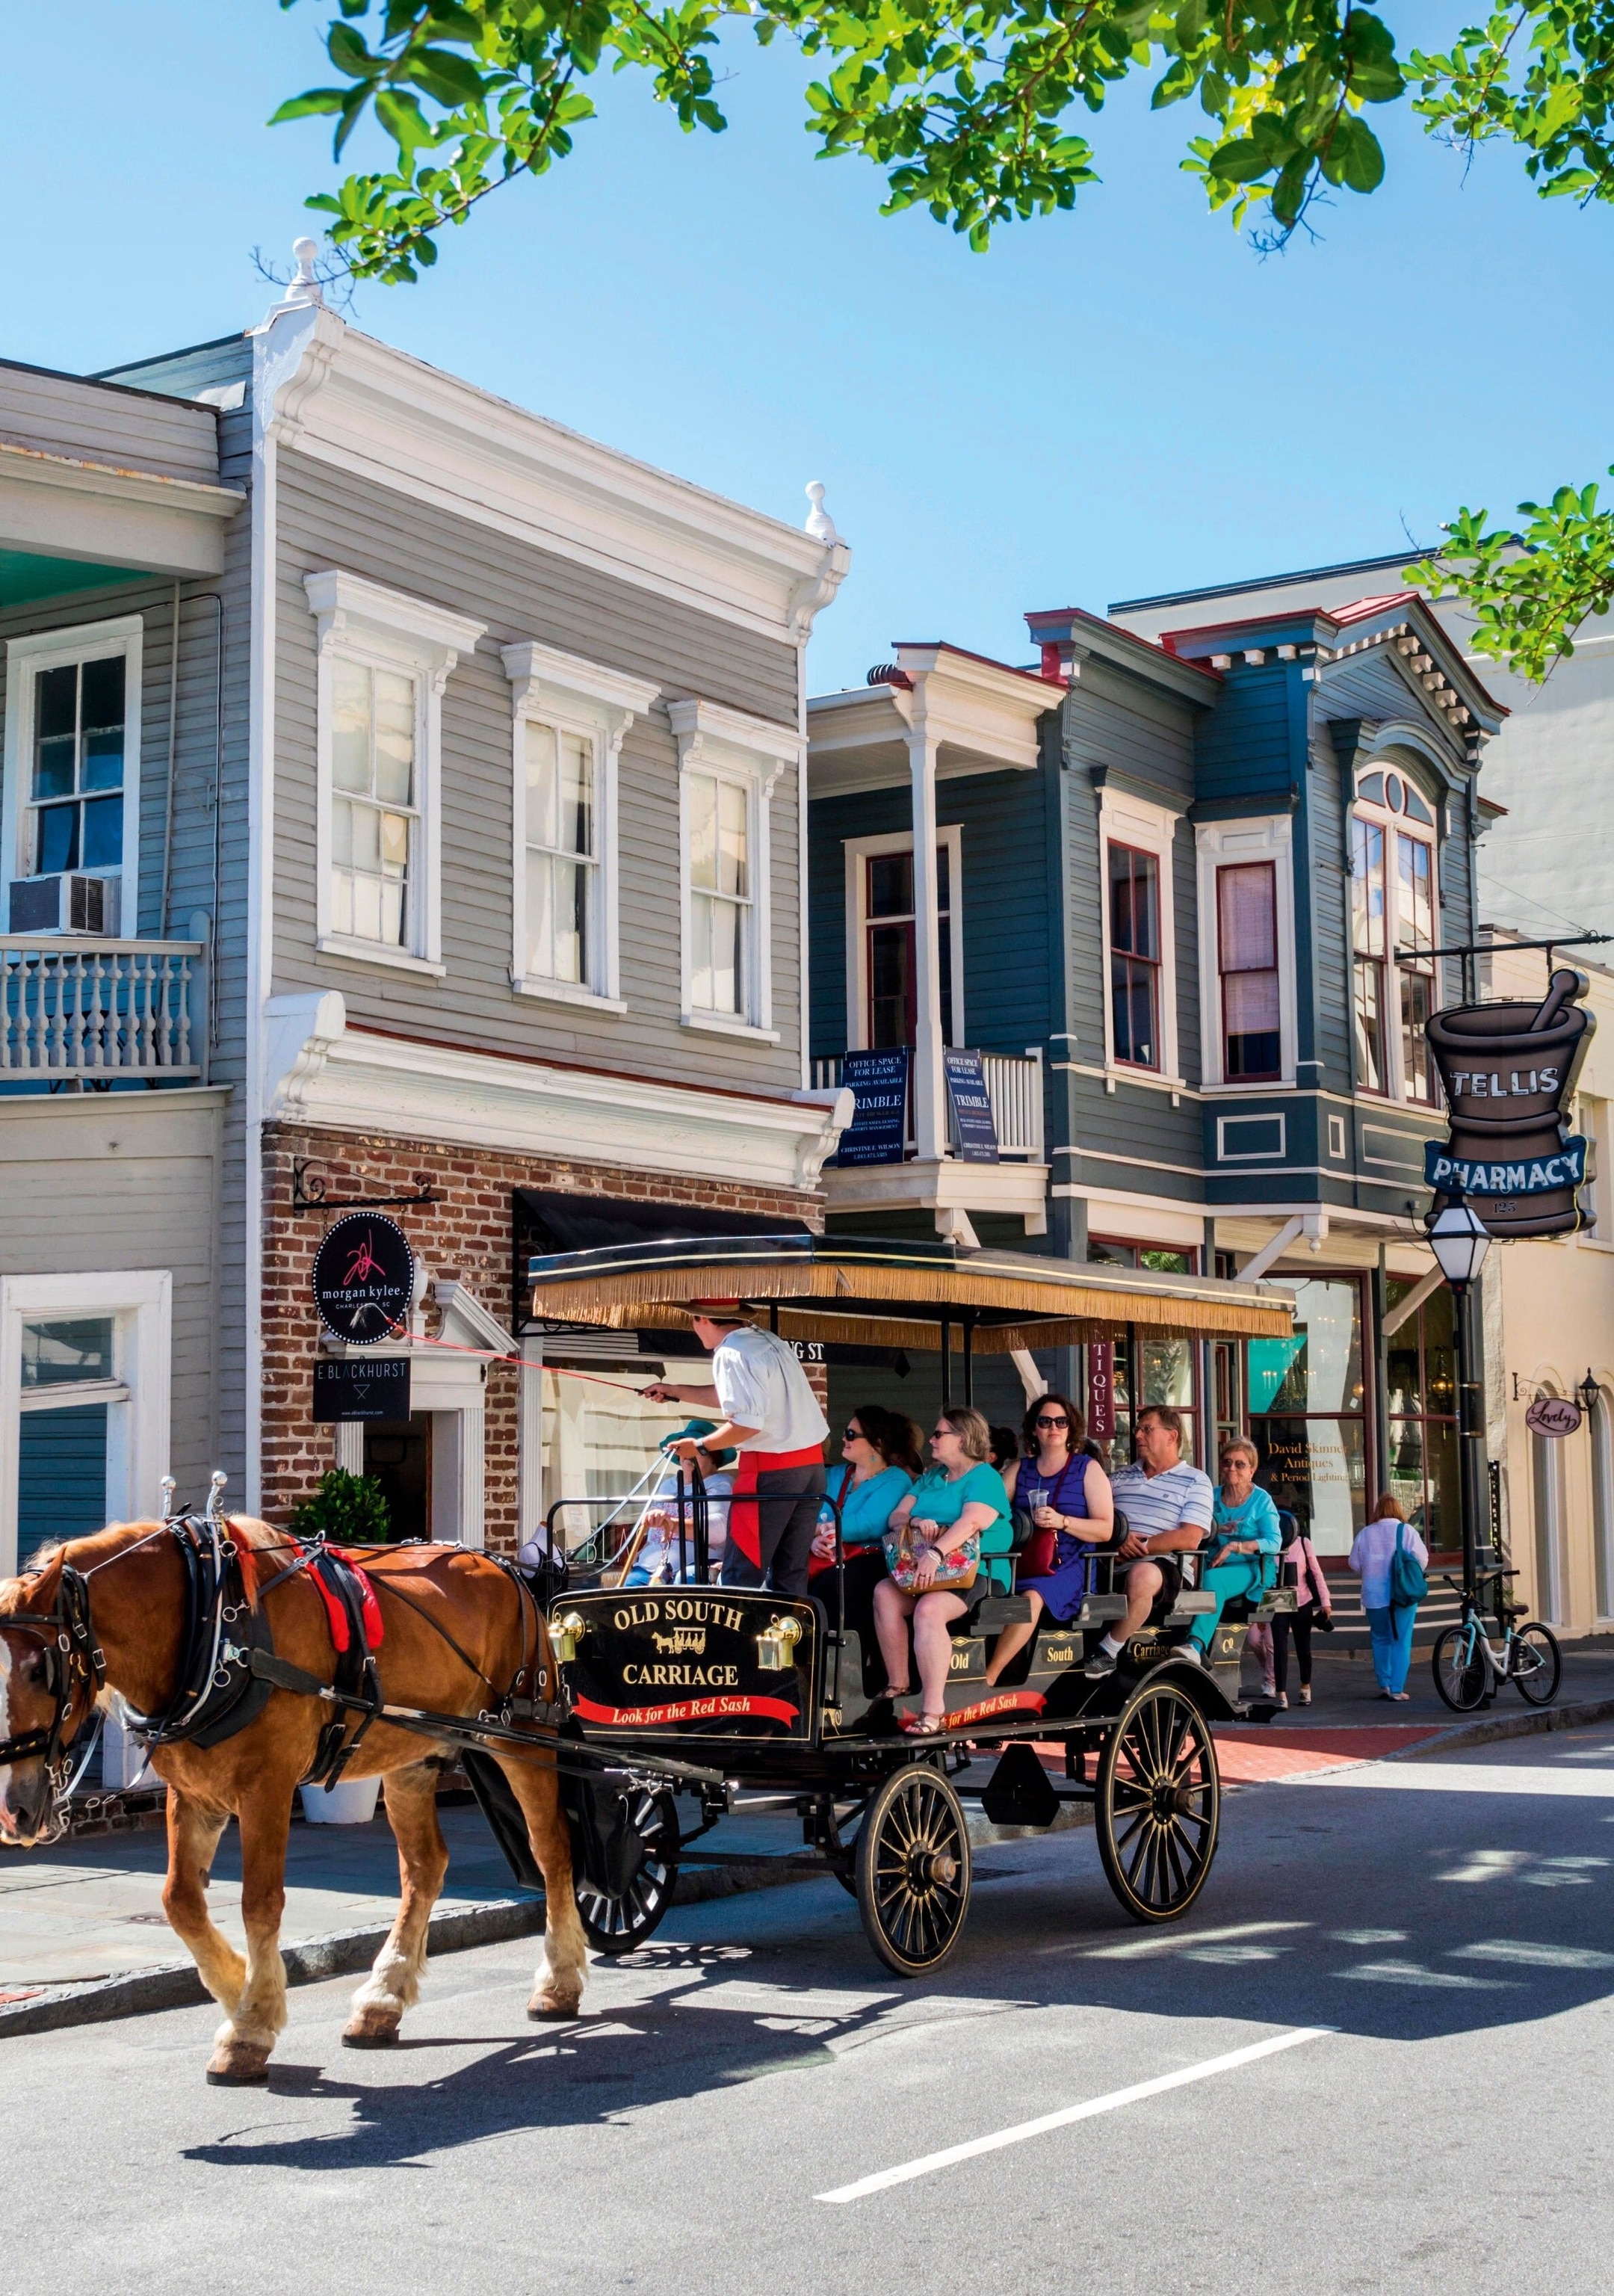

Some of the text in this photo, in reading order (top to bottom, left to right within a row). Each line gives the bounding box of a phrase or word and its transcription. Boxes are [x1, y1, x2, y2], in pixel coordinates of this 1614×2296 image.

[849, 1057, 902, 1069] OFFICE SPACE
[947, 1057, 979, 1067] OFFICE SPACE
[854, 1066, 896, 1076] FOR LEASE
[961, 1067, 977, 1075] LEASE
[871, 1077, 903, 1086] AVAILABLE
[1449, 1067, 1559, 1097] TELLIS
[855, 1095, 902, 1110] RIMBLE
[954, 1094, 989, 1108] TRIMBLE
[1433, 1152, 1580, 1191] PHARMACY
[1493, 1201, 1517, 1214] 125
[322, 1285, 404, 1301] morgan kylee.
[807, 1343, 824, 1360] ST
[1528, 1401, 1577, 1432] Lovely
[1269, 1442, 1349, 1454] David Skinner
[1284, 1457, 1334, 1470] Antiques
[1270, 1472, 1349, 1484] & Period Lighting
[613, 1599, 743, 1632] OLD SOUTH
[950, 1653, 969, 1670] Old
[1047, 1646, 1073, 1662] South
[622, 1664, 739, 1686] CARRIAGE
[612, 1695, 750, 1723] Look for the Red Sash
[947, 1712, 962, 1729] for
[964, 1706, 977, 1722] the
[980, 1699, 996, 1717] Red
[998, 1694, 1018, 1710] Sash
